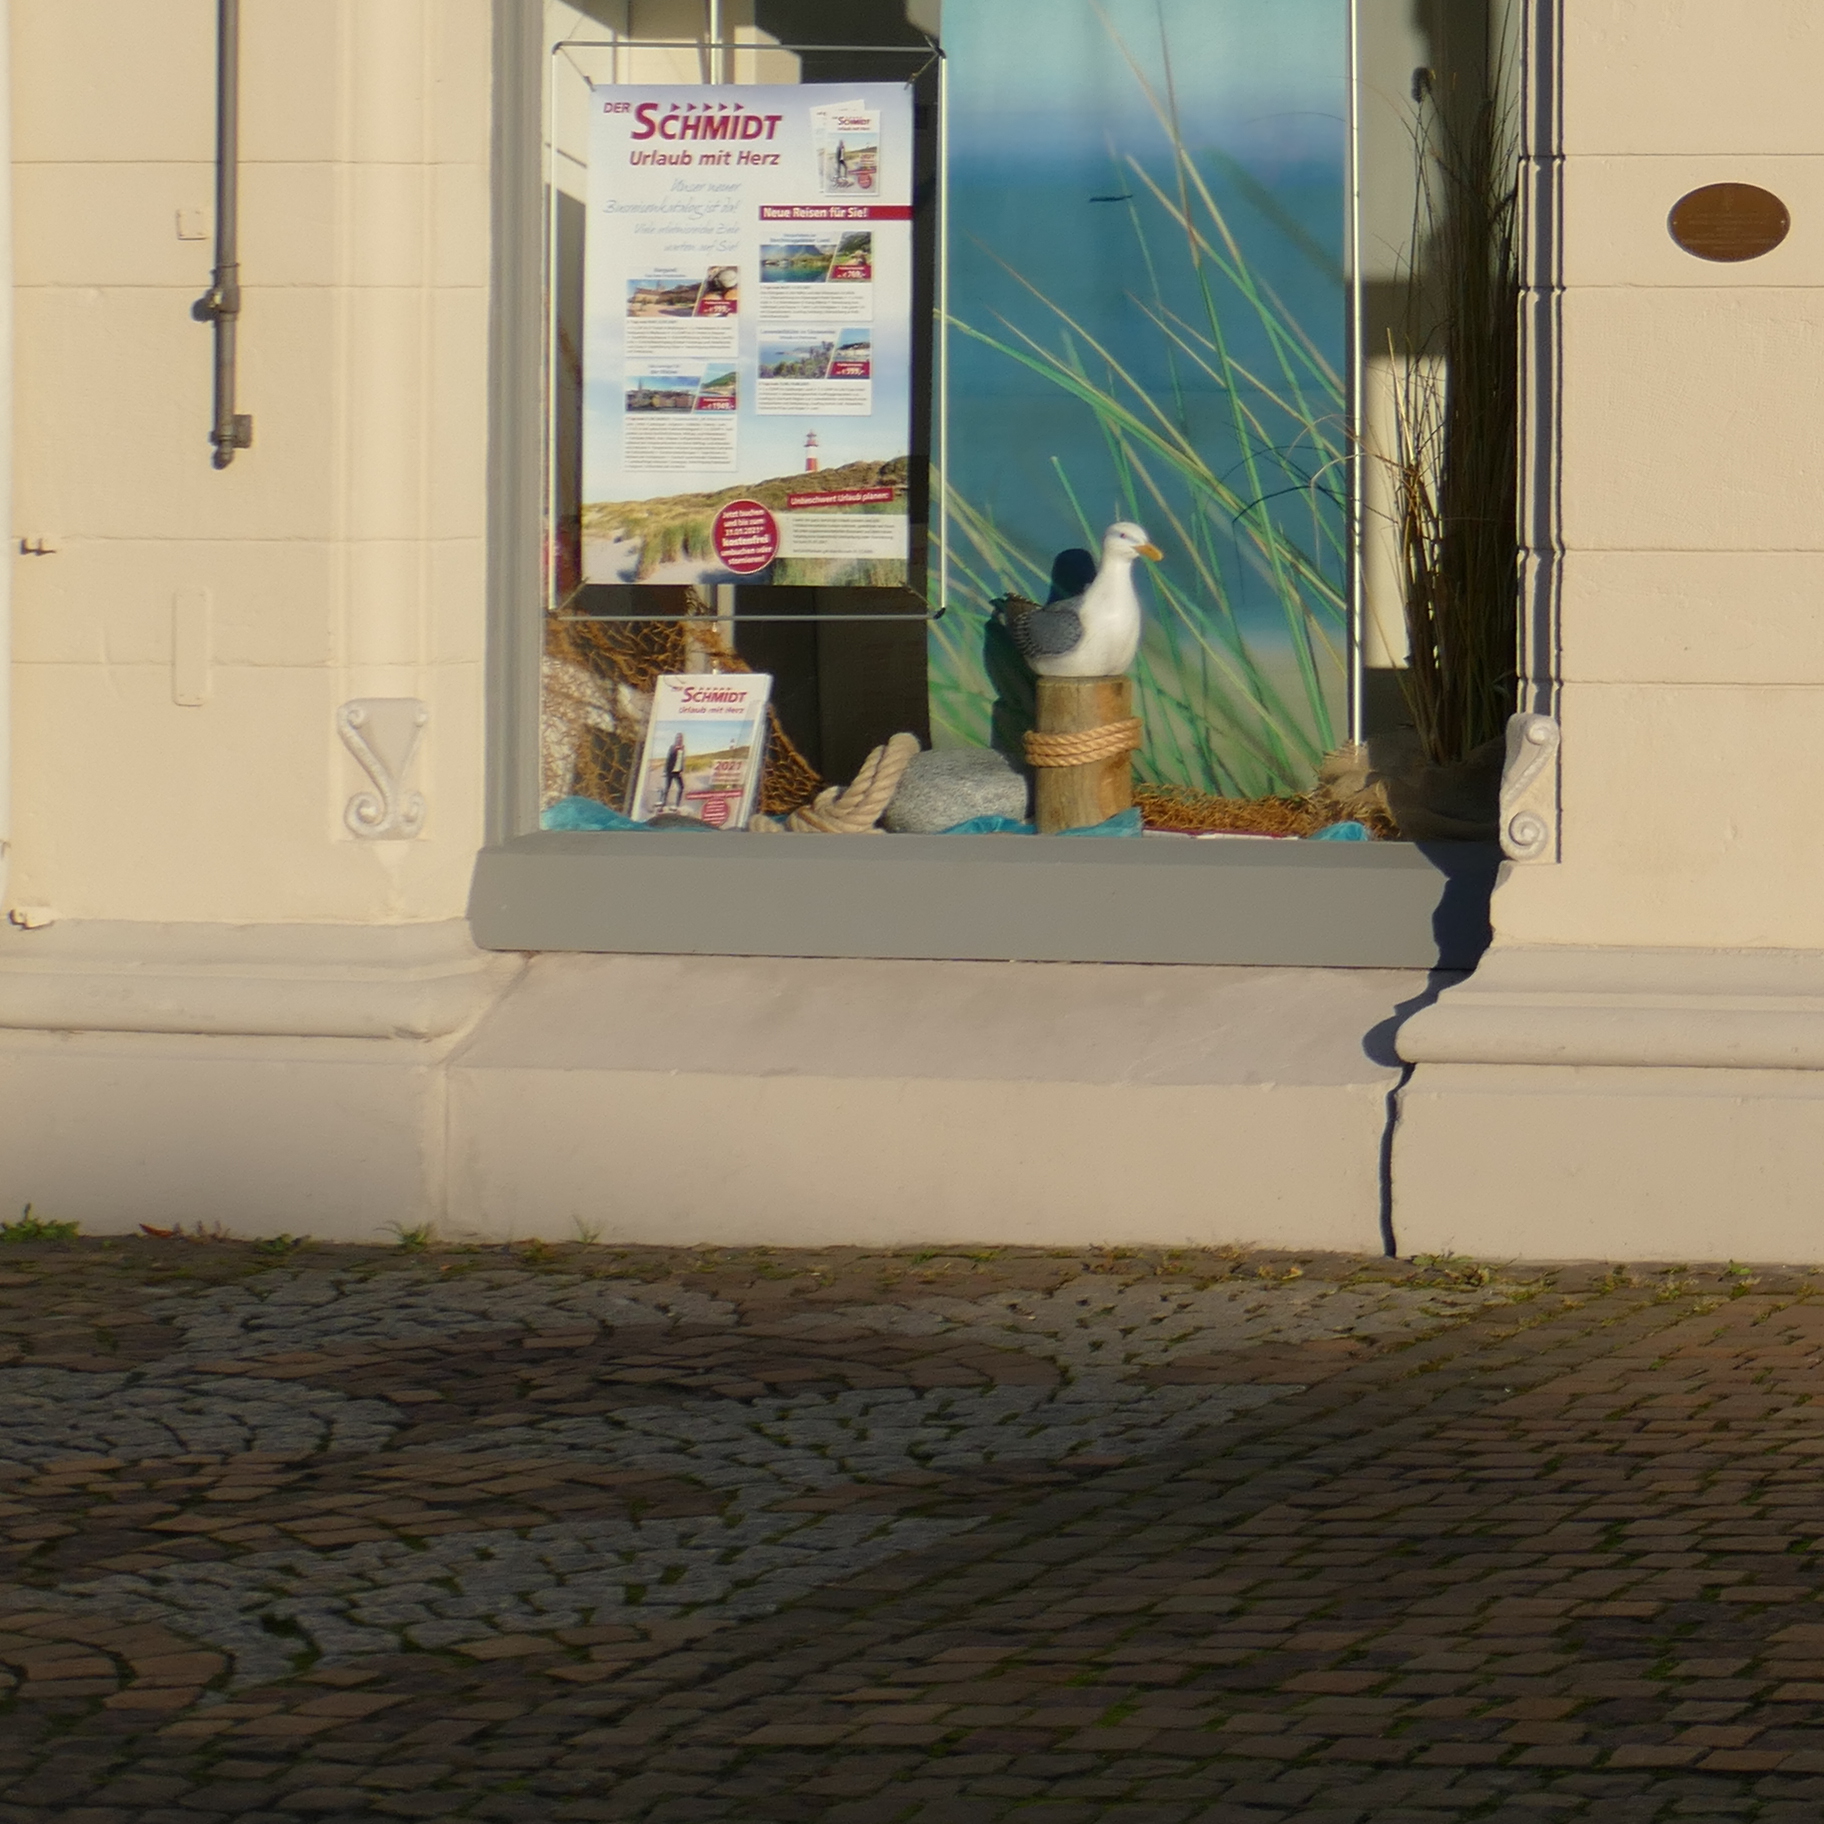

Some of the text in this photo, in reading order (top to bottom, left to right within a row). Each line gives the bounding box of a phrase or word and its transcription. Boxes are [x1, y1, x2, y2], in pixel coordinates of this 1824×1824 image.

[603, 102, 782, 140] DER SCHMIDT
[629, 150, 780, 166] Urlaub mit Herz
[763, 206, 868, 218] Neue Reisen für Sie!
[722, 536, 769, 547] kostenfrei
[681, 687, 747, 702] SCHMIDT
[714, 762, 743, 771] 2021
